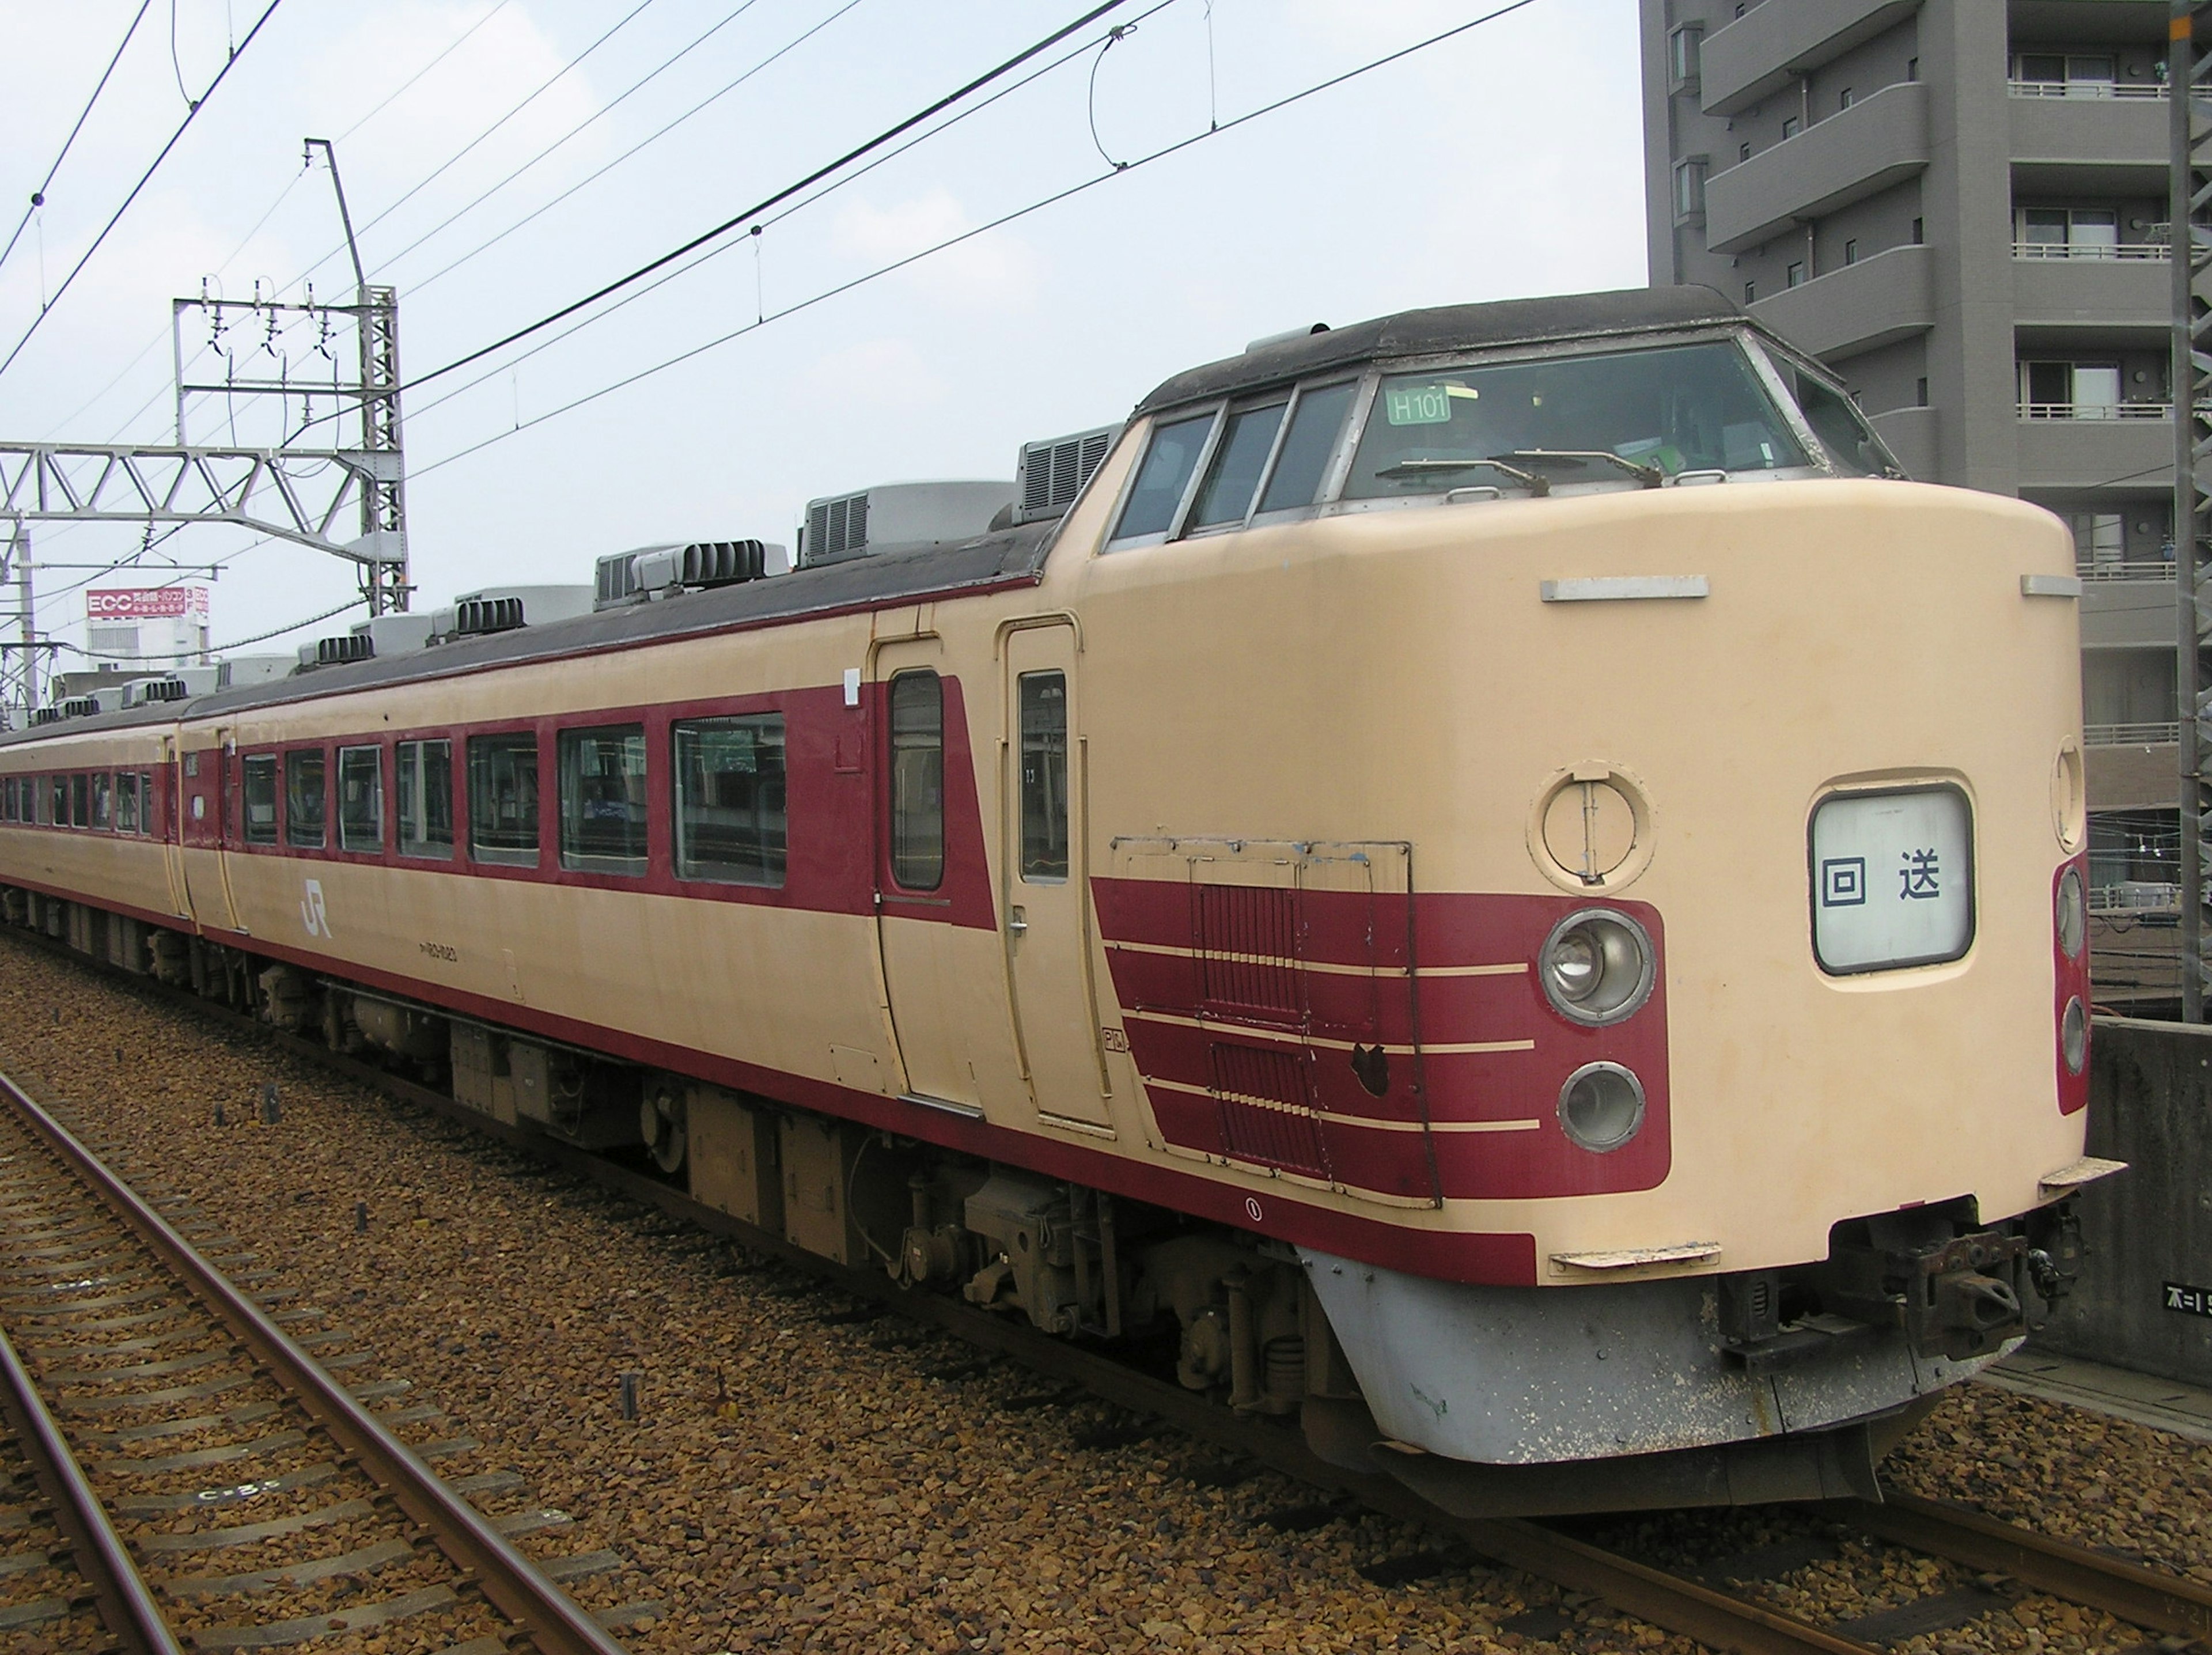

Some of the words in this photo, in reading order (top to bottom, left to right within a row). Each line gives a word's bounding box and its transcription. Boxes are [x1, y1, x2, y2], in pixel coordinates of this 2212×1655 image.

[87, 594, 132, 612] ECC
[1823, 848, 1940, 908] 回送
[301, 879, 332, 938] JR
